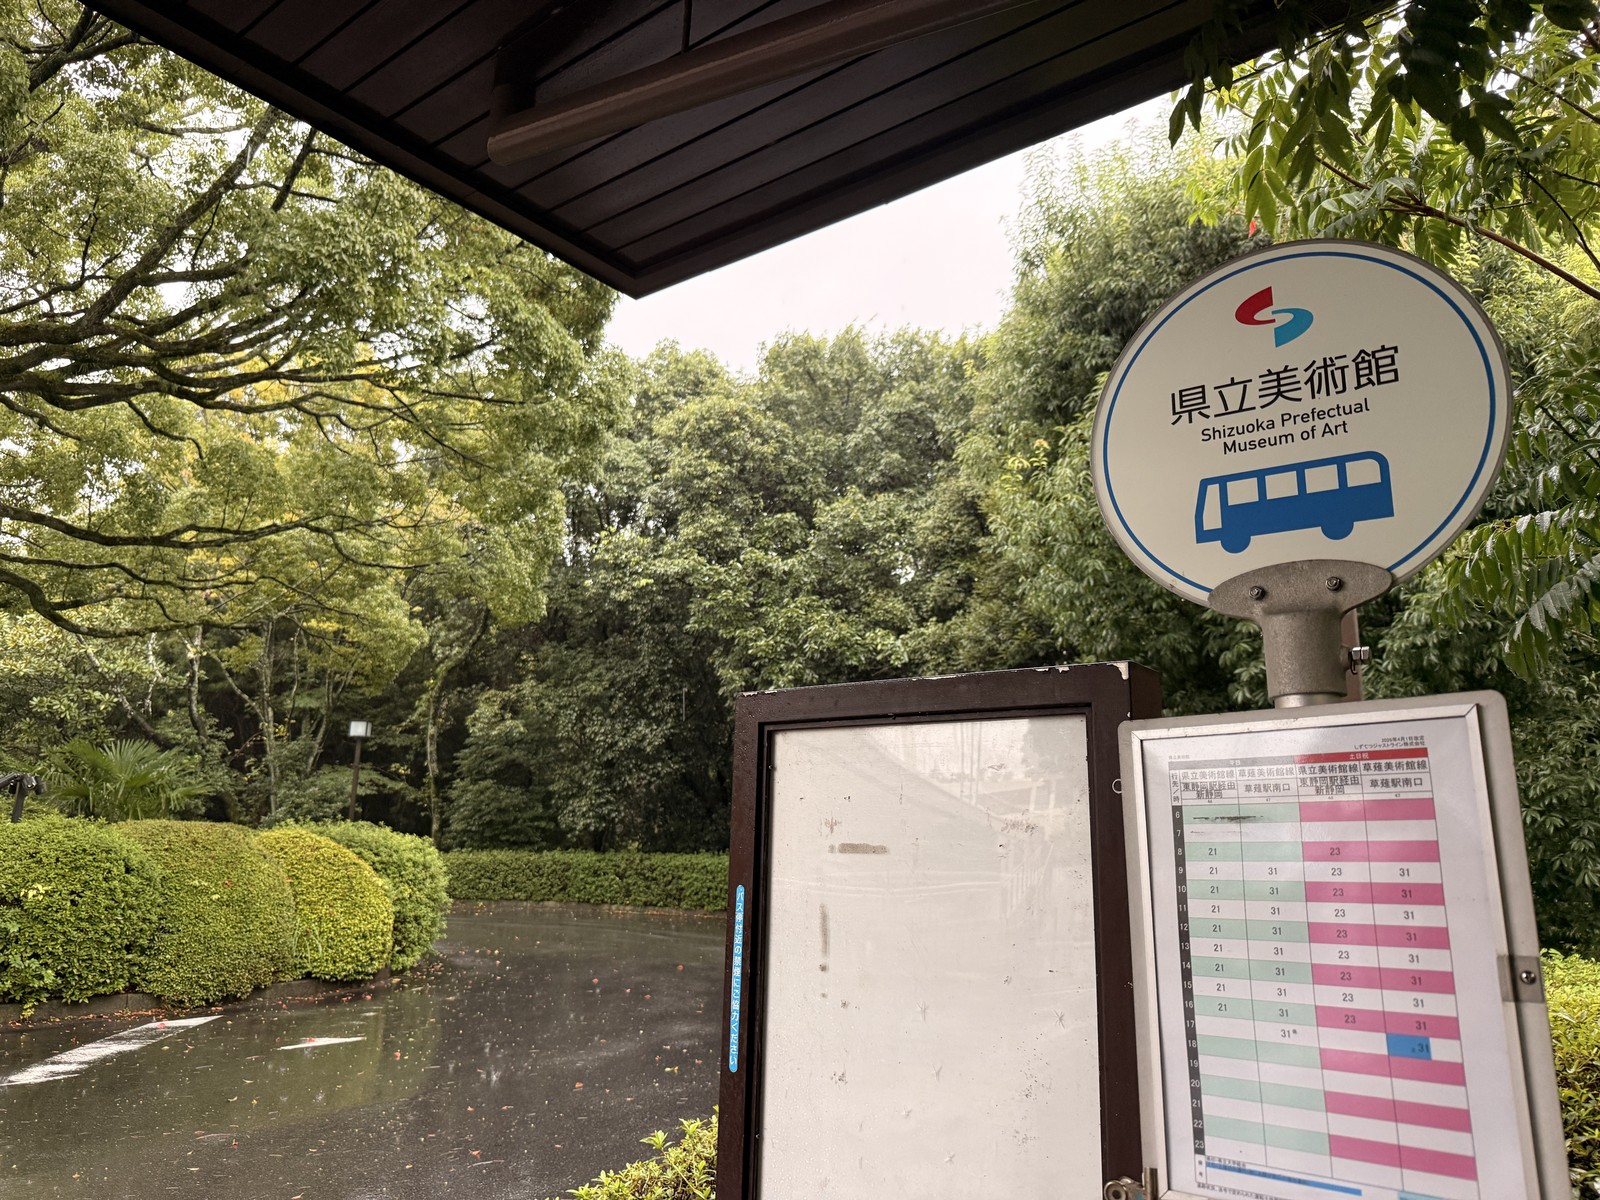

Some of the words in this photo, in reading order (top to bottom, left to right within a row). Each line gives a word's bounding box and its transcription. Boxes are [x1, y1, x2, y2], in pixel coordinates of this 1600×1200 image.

[1170, 344, 1400, 426] 県立美術館
[1201, 418, 1276, 443] Shizuoka
[1281, 397, 1371, 428] Prefectual
[1222, 433, 1296, 456] Museum
[1300, 426, 1317, 441] of
[1321, 419, 1349, 437] Art
[1237, 764, 1295, 777] 草薙美術館線
[1298, 763, 1359, 776] 県立美術館線
[1362, 759, 1428, 773] 草薙美術館線
[1181, 770, 1235, 780] 県立美術館線
[1244, 783, 1291, 793] 草薙駅南口
[1369, 776, 1423, 789] 草薙駅南口
[1175, 810, 1180, 819] 6
[1177, 829, 1181, 837] 7
[1178, 847, 1183, 855] 8
[1179, 866, 1183, 874] 9
[1269, 867, 1277, 875] 31
[1331, 868, 1342, 876] 23
[1400, 868, 1409, 877] 31
[1178, 885, 1186, 893] 10
[1270, 887, 1278, 895] 31
[1333, 888, 1343, 896] 23
[1402, 889, 1412, 898] 31
[1178, 904, 1186, 912] 11
[1212, 905, 1219, 913] 21
[1271, 907, 1280, 915] 31
[1335, 909, 1345, 917] 23
[1404, 911, 1414, 919] 31
[1179, 923, 1188, 931] 12
[1213, 924, 1221, 932] 21
[1272, 927, 1281, 935] 31
[1337, 929, 1347, 938] 23
[1406, 932, 1416, 941] 31
[1181, 942, 1190, 950] 13
[1274, 947, 1283, 955] 31
[1338, 951, 1349, 959] 23
[1409, 954, 1419, 963] 31
[1182, 961, 1191, 969] 14
[1276, 968, 1284, 976] 31
[1341, 972, 1351, 980] 23
[1412, 976, 1421, 985] 31
[1183, 981, 1192, 989] 15
[1217, 983, 1225, 991] 21
[1277, 988, 1286, 996] 31
[1342, 993, 1353, 1002] 23
[1413, 998, 1424, 1007] 31
[1184, 1000, 1193, 1008] 16
[1218, 1003, 1226, 1011] 21
[1279, 1009, 1288, 1017] 31
[1345, 1014, 1356, 1024] 23
[1416, 1021, 1426, 1030] 31
[1186, 1020, 1195, 1028] 17
[1188, 1039, 1197, 1048] 18
[1189, 1059, 1198, 1068] 19
[1191, 1079, 1200, 1088] 20
[1192, 1099, 1201, 1108] 21
[1193, 1120, 1203, 1129] 22
[1195, 1140, 1204, 1149] 23
